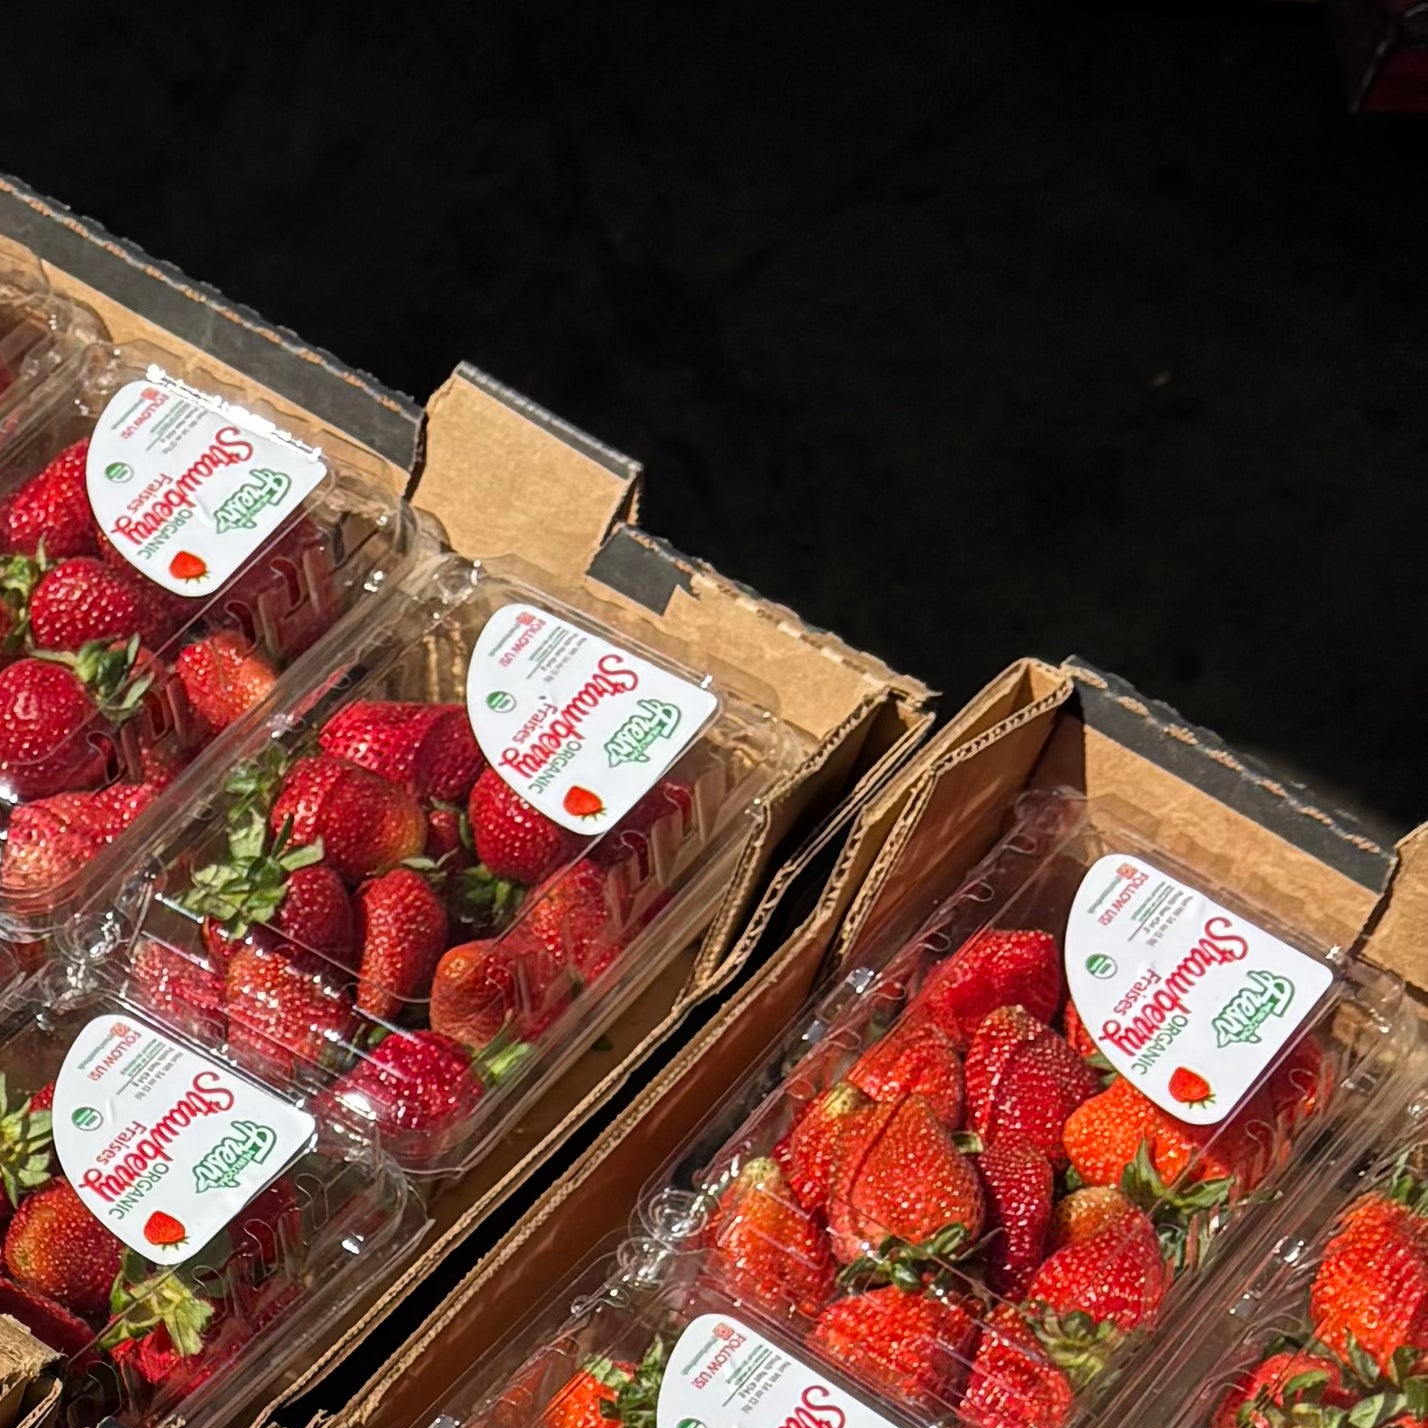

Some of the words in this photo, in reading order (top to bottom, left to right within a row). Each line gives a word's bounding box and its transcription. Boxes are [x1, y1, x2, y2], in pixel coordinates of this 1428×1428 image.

[111, 427, 253, 545] Strawberry
[138, 508, 193, 560] ORGANIC
[498, 655, 639, 778] Strawberry
[512, 701, 559, 744] Fraises
[528, 740, 582, 795] ORGANIC
[1099, 917, 1249, 1057] Strawberry
[1114, 968, 1163, 1016] Fraises
[1131, 1015, 1188, 1076] ORGANIC
[79, 1071, 235, 1202] Strawberry
[96, 1119, 148, 1164] Fraises
[108, 1163, 169, 1220] ORGANIC
